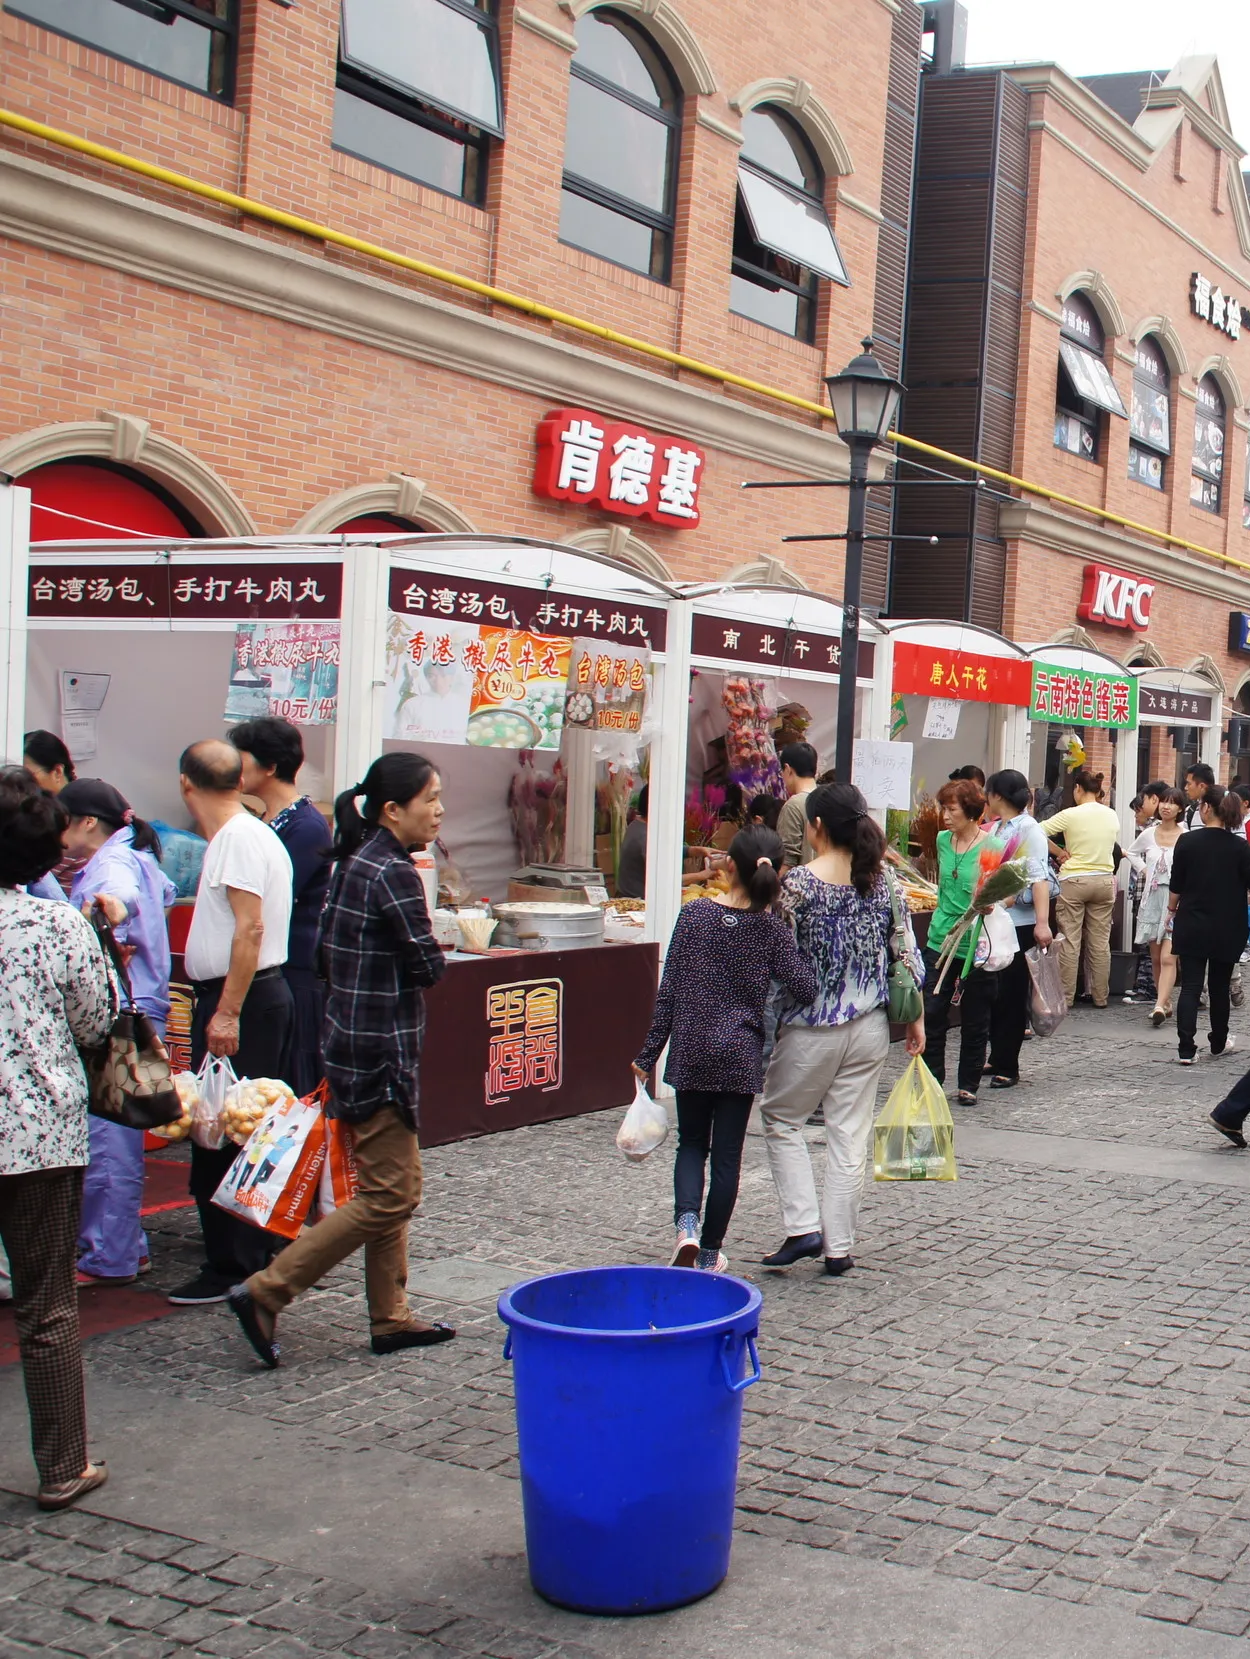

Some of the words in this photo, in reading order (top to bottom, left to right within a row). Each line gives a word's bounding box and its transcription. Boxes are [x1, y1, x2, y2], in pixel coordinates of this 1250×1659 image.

[558, 419, 701, 519] 肯德基
[33, 576, 326, 606] 台湾汤包、手打牛肉丸
[1092, 570, 1155, 626] KFC
[723, 628, 841, 665] 南北干货
[576, 651, 645, 690] 台湾汤包
[930, 662, 988, 691] 唐人干花
[272, 698, 333, 719] 10元/份
[1034, 671, 1130, 723] 云南特色酱菜
[597, 710, 640, 730] 10元/份
[284, 1183, 308, 1222] camel
